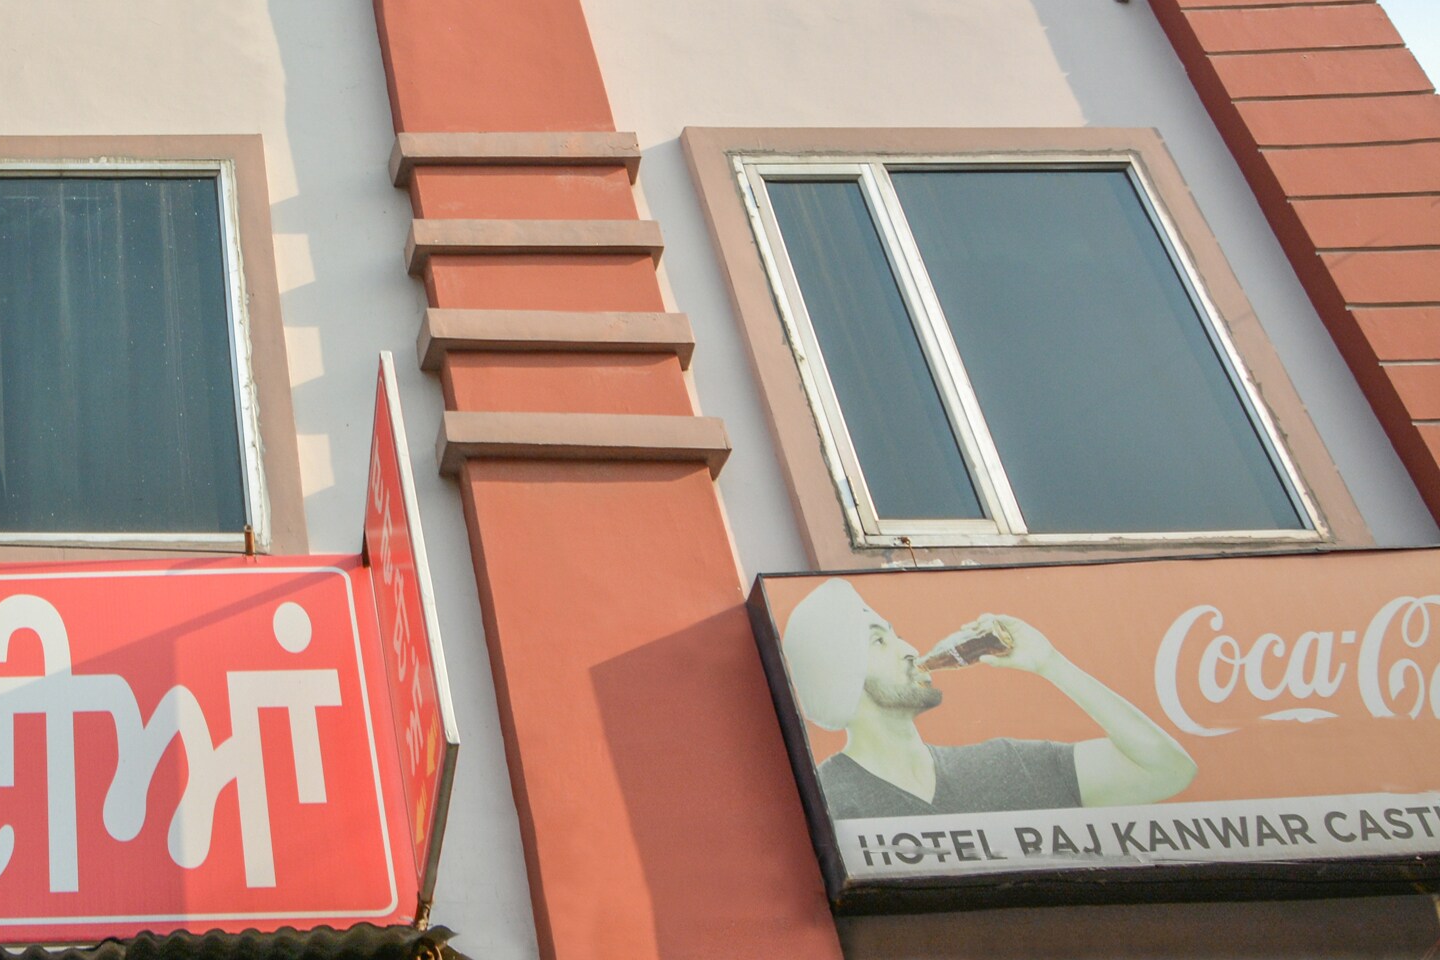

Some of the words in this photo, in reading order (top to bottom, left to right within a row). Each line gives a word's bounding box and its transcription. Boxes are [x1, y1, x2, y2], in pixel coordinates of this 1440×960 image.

[1154, 594, 1440, 737] Coca-C
[858, 828, 1008, 866] HOTEL
[1014, 823, 1103, 858] RAJ
[1111, 813, 1317, 857] KANWAR
[1323, 805, 1440, 842] CAST
